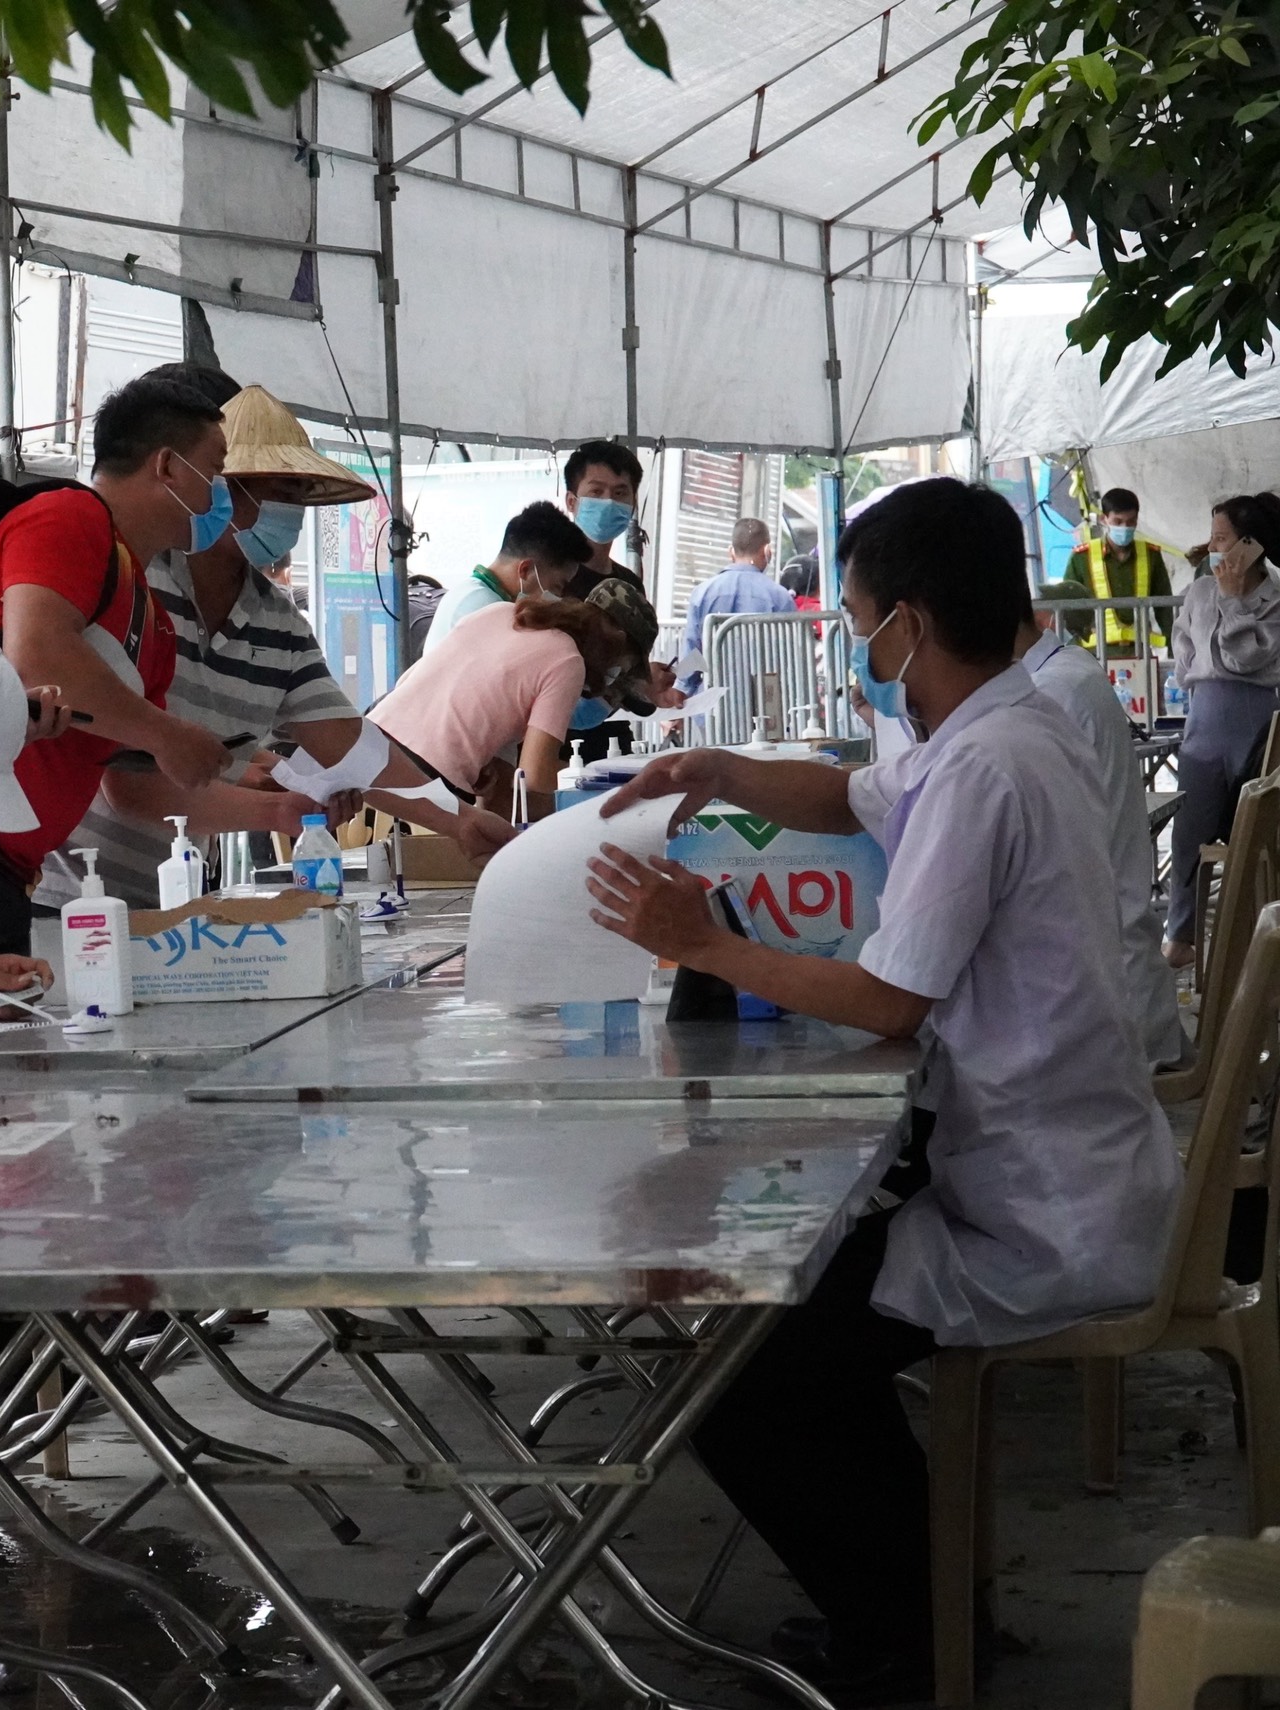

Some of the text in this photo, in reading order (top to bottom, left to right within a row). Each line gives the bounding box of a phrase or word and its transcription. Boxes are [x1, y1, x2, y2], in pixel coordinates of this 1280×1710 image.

[679, 856, 709, 868] WATE
[712, 856, 765, 868] MINERAL
[212, 953, 288, 965] The Smart Choice
